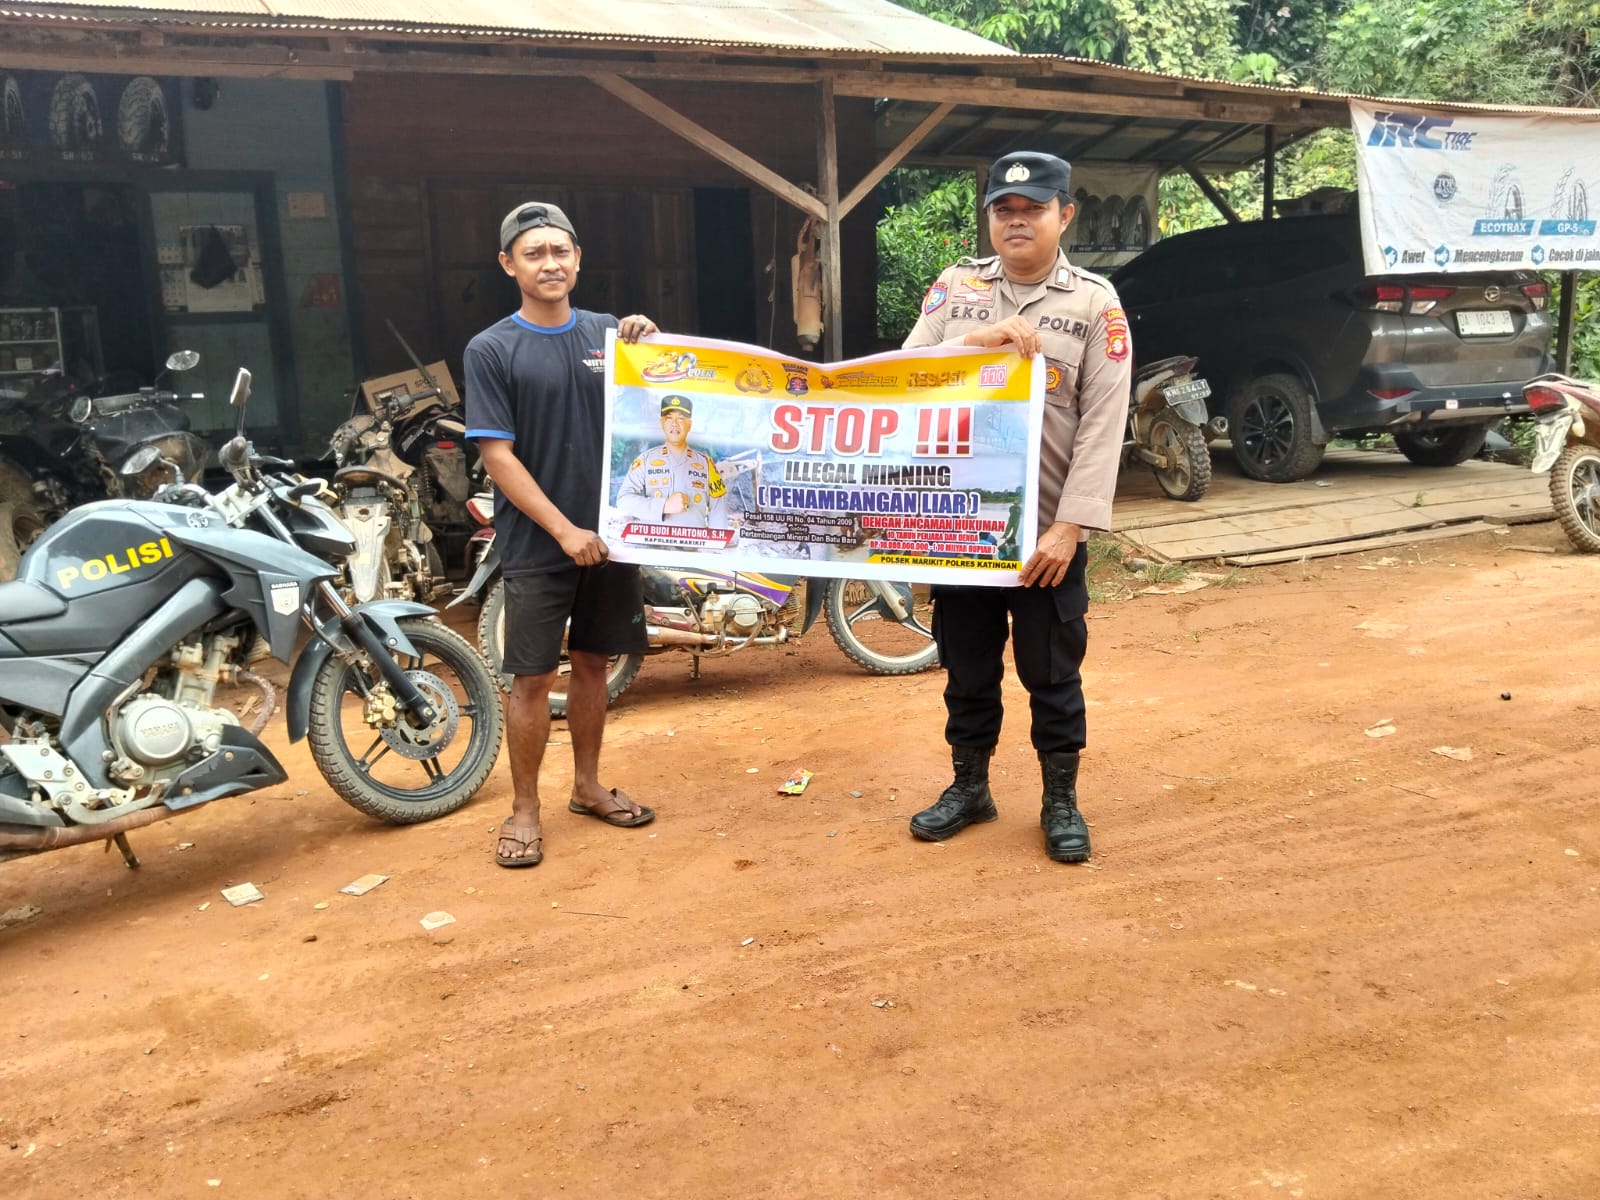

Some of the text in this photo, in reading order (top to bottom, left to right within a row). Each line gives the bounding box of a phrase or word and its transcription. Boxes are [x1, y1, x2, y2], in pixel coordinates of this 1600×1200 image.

[1480, 223, 1527, 233] ECOTRAX
[1401, 249, 1425, 263] Awet
[1453, 250, 1524, 264] Mencengkeram
[1549, 248, 1574, 261] Cocok
[951, 305, 990, 321] EKO
[1038, 315, 1088, 338] POLRI
[981, 369, 1005, 384] 110
[770, 404, 971, 455] STOP !!!
[688, 470, 708, 478] POLRI
[785, 460, 951, 486] ILLEGAL MINNING
[776, 514, 786, 522] UU
[817, 516, 836, 526] Tahun
[862, 516, 1005, 532] DENGAN ANCAMAN HUKUMAN
[630, 524, 728, 540] IPTU BUDI HARTONO, S.H.
[740, 529, 858, 545] Pertambangan Mineral Dan Batu Bara
[56, 536, 175, 590] POLISI
[880, 556, 1018, 570] POLSEK MARIKIT POLRES KATINGAN
